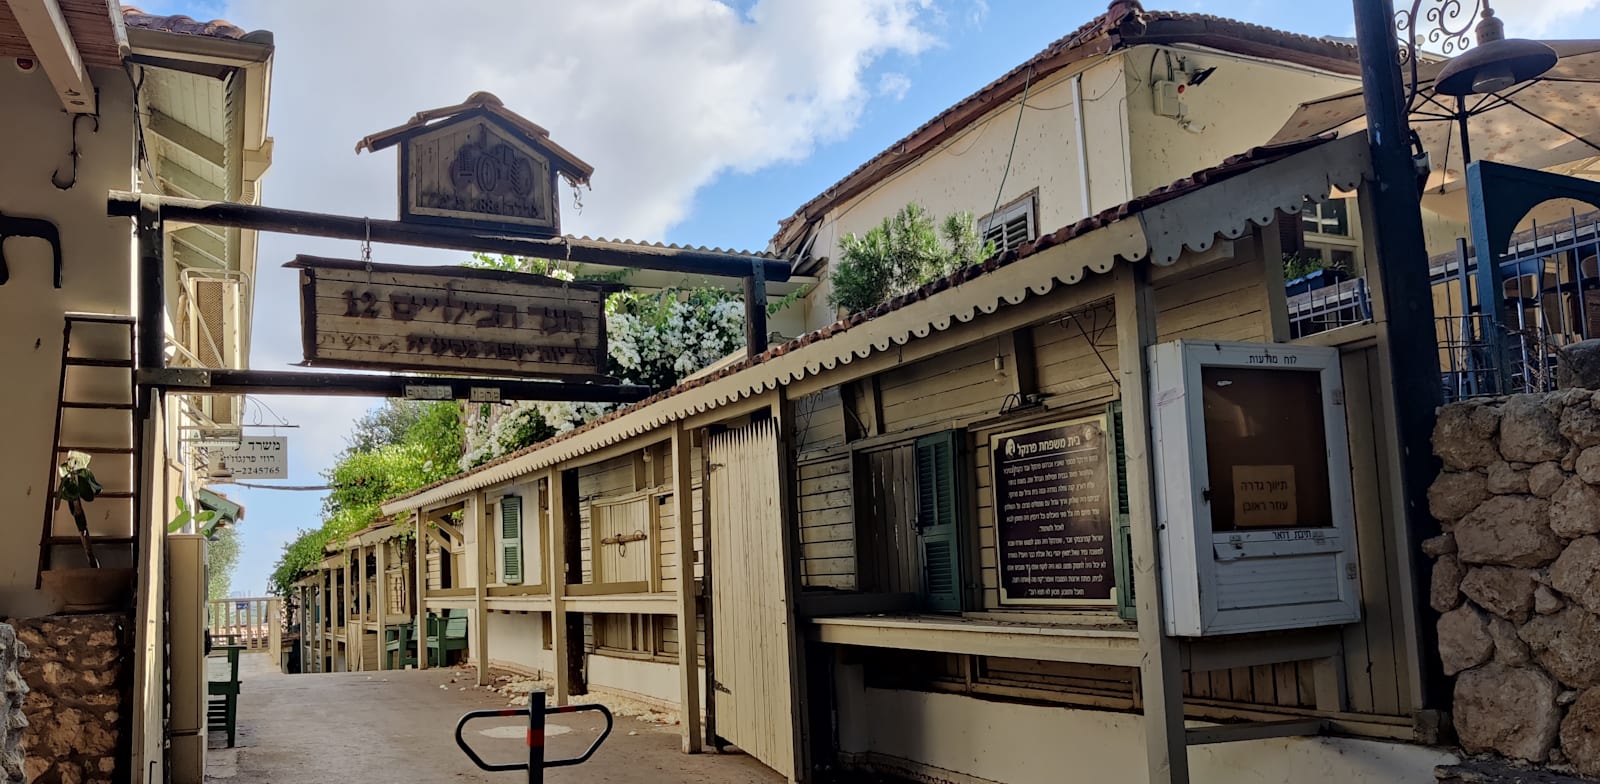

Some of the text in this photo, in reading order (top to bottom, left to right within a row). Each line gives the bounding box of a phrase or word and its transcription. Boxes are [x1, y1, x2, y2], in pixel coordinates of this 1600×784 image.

[342, 289, 380, 319] 12
[1283, 355, 1297, 365] לוח
[248, 441, 281, 451] משרד
[1016, 435, 1081, 457] בית משפחת פרנקל
[1241, 481, 1264, 491] גדרה
